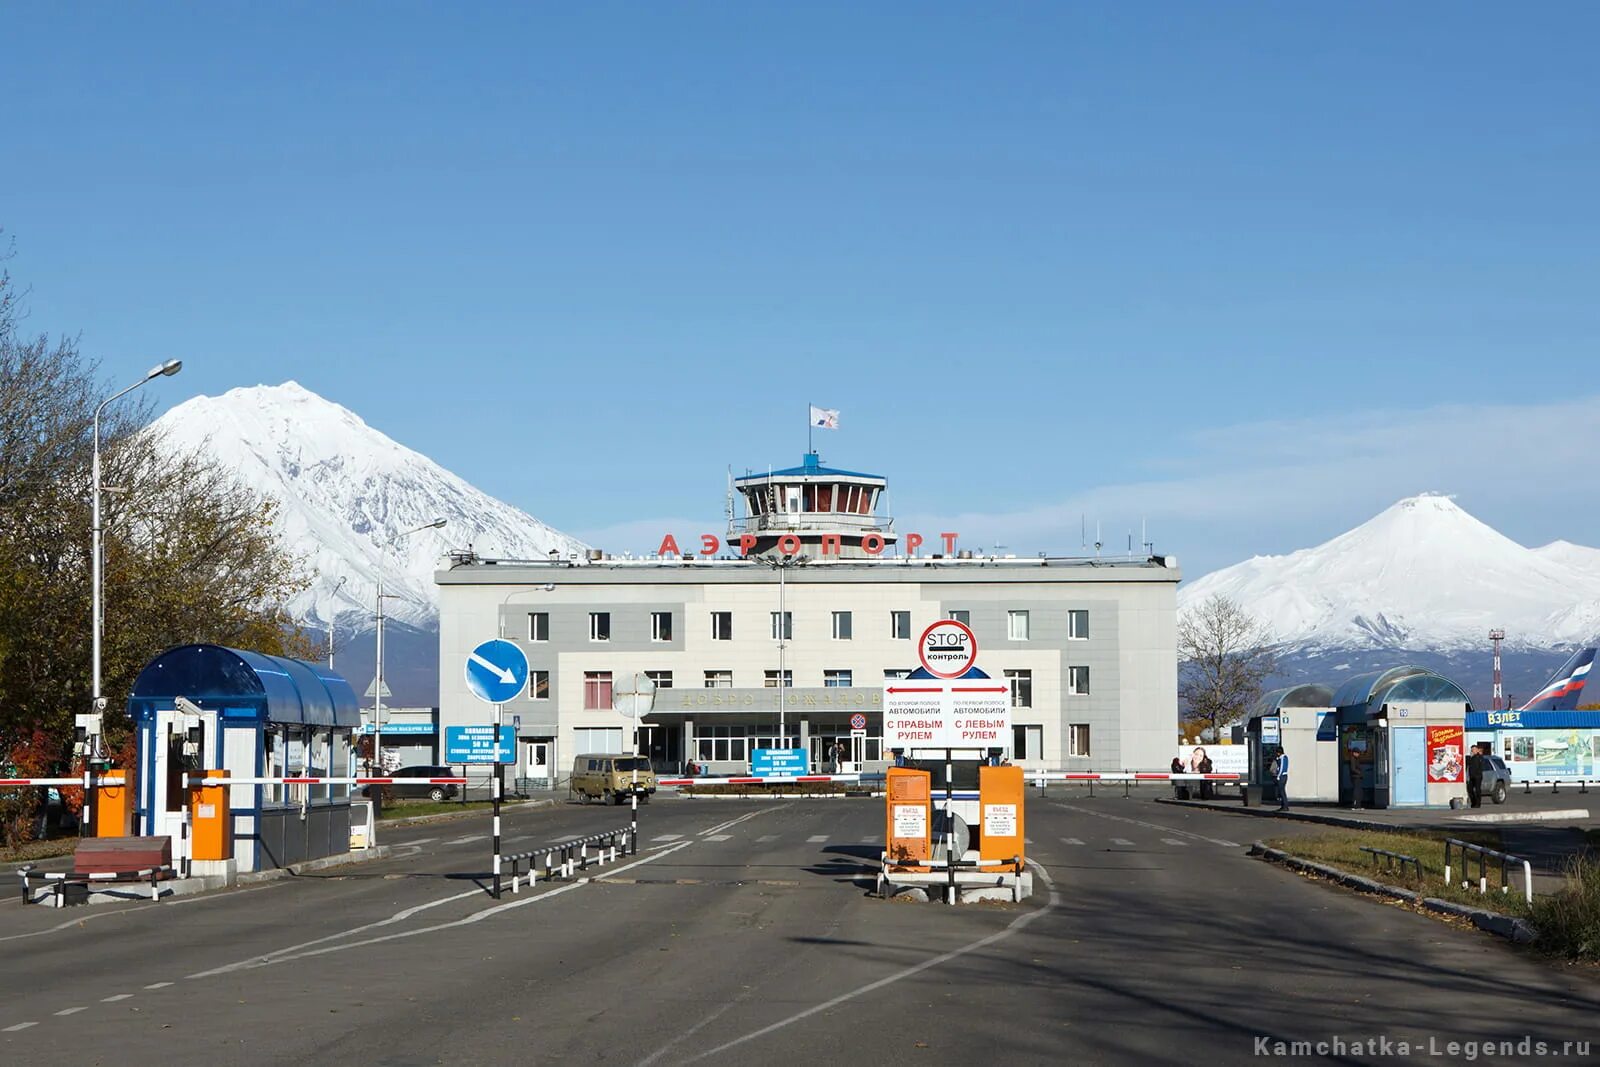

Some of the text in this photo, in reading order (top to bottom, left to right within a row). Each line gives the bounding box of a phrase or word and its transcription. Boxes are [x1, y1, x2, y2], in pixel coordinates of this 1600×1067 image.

[657, 533, 959, 555] АЭРОПОРТ
[927, 633, 969, 646] STOP
[773, 694, 881, 706] ПОЖАЛОВ
[887, 720, 943, 729] С ПРАВЫМ
[955, 720, 1005, 729] С ЛЕВЫМ
[898, 731, 933, 740] РУЛЕМ
[962, 731, 997, 739] РУЛЕМ
